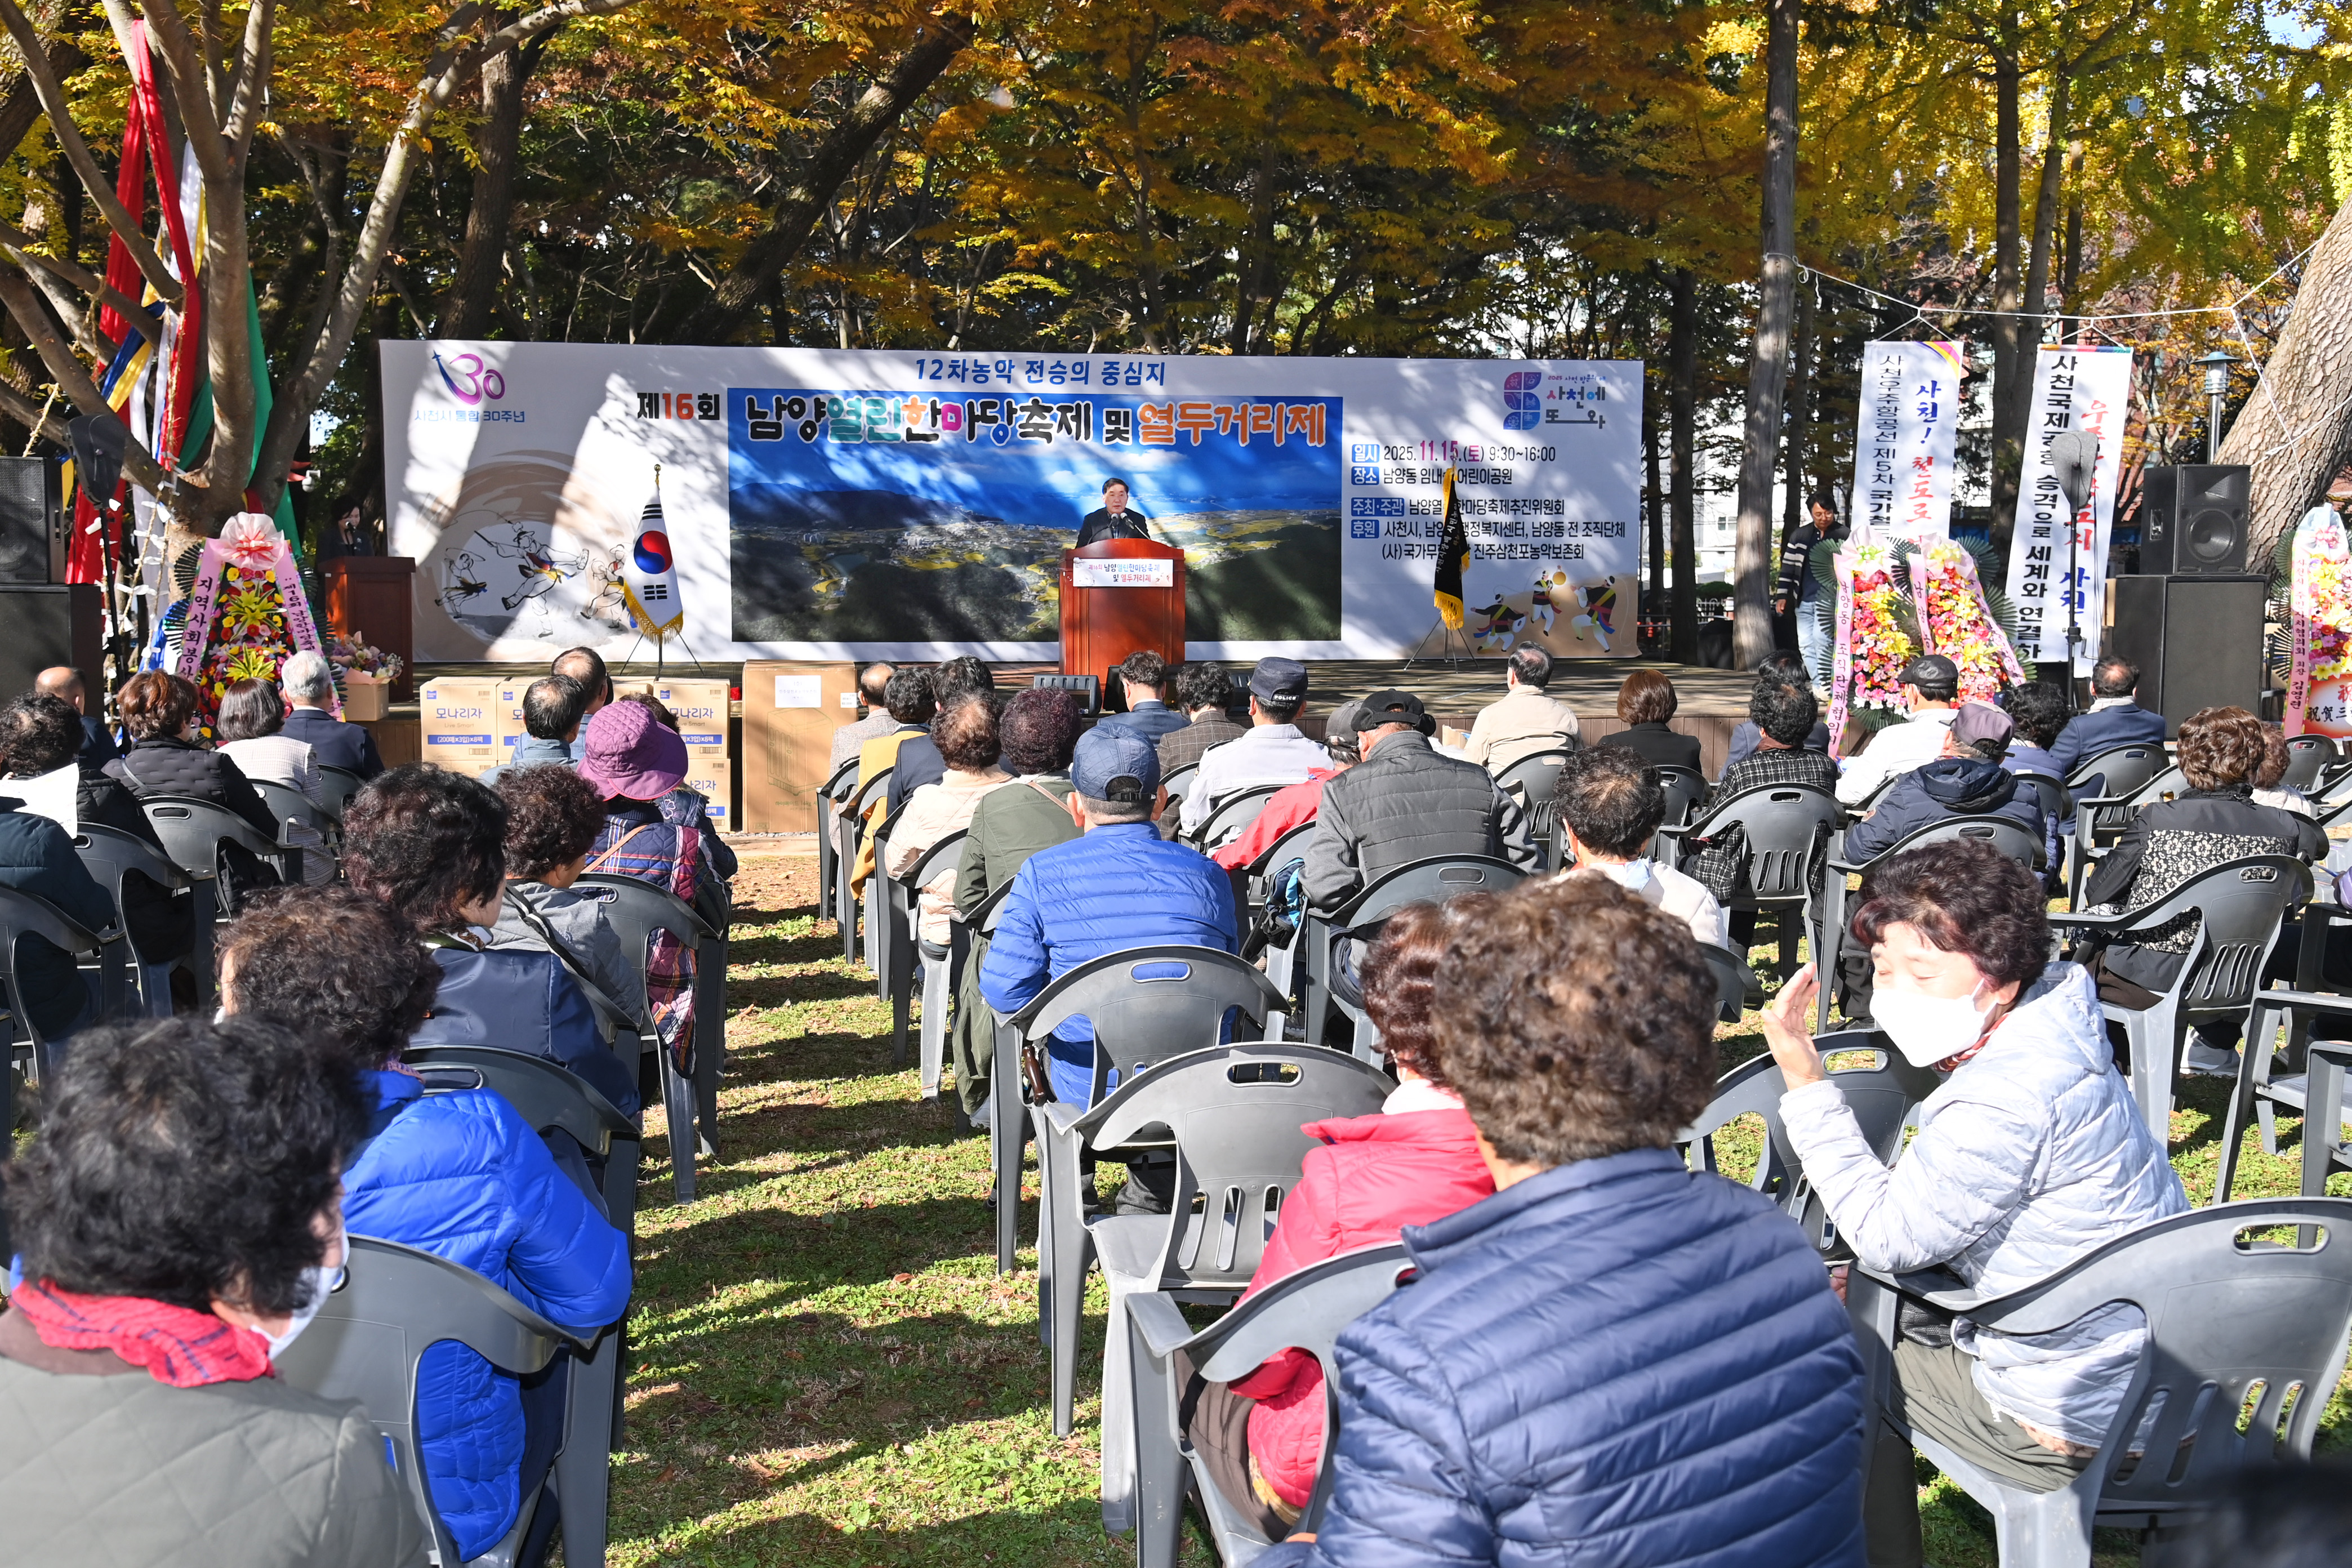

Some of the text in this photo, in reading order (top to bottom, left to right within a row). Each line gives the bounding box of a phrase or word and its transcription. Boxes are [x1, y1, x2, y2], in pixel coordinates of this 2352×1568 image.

[915, 359, 1166, 386] 12차농악 전승의 중심지
[637, 393, 720, 421] 제16회
[1547, 386, 1606, 409] 사천에
[1874, 355, 1904, 443] 사천우주항공선
[415, 411, 525, 422] 사천시 통합 30주년
[1103, 408, 1132, 445] 및
[1137, 401, 1326, 447] 열두거리제
[1916, 380, 1941, 444] 사천!
[1354, 444, 1378, 462] 일시
[1489, 446, 1556, 461] 9:30~16:00
[1871, 448, 1896, 485] 제5차
[1353, 467, 1512, 484] 장소 남양동 임내 어린이공원
[1906, 456, 1934, 523] 철도로
[1353, 498, 1565, 515] 주최·주관 남양열한마당축제추진위원회
[2031, 475, 2060, 538] 승격으로
[1353, 519, 1375, 538] 후원
[1384, 521, 1422, 539] 사천시,
[1425, 521, 1528, 539] 남양행정복지센터,
[1532, 521, 1565, 538] 남양동
[1567, 521, 1578, 538] 전
[1582, 521, 1625, 538] 조직단체
[1474, 543, 1584, 560] 진주삼천포농악보존회
[2021, 546, 2051, 598] 세계와
[436, 708, 482, 719] 모나리자
